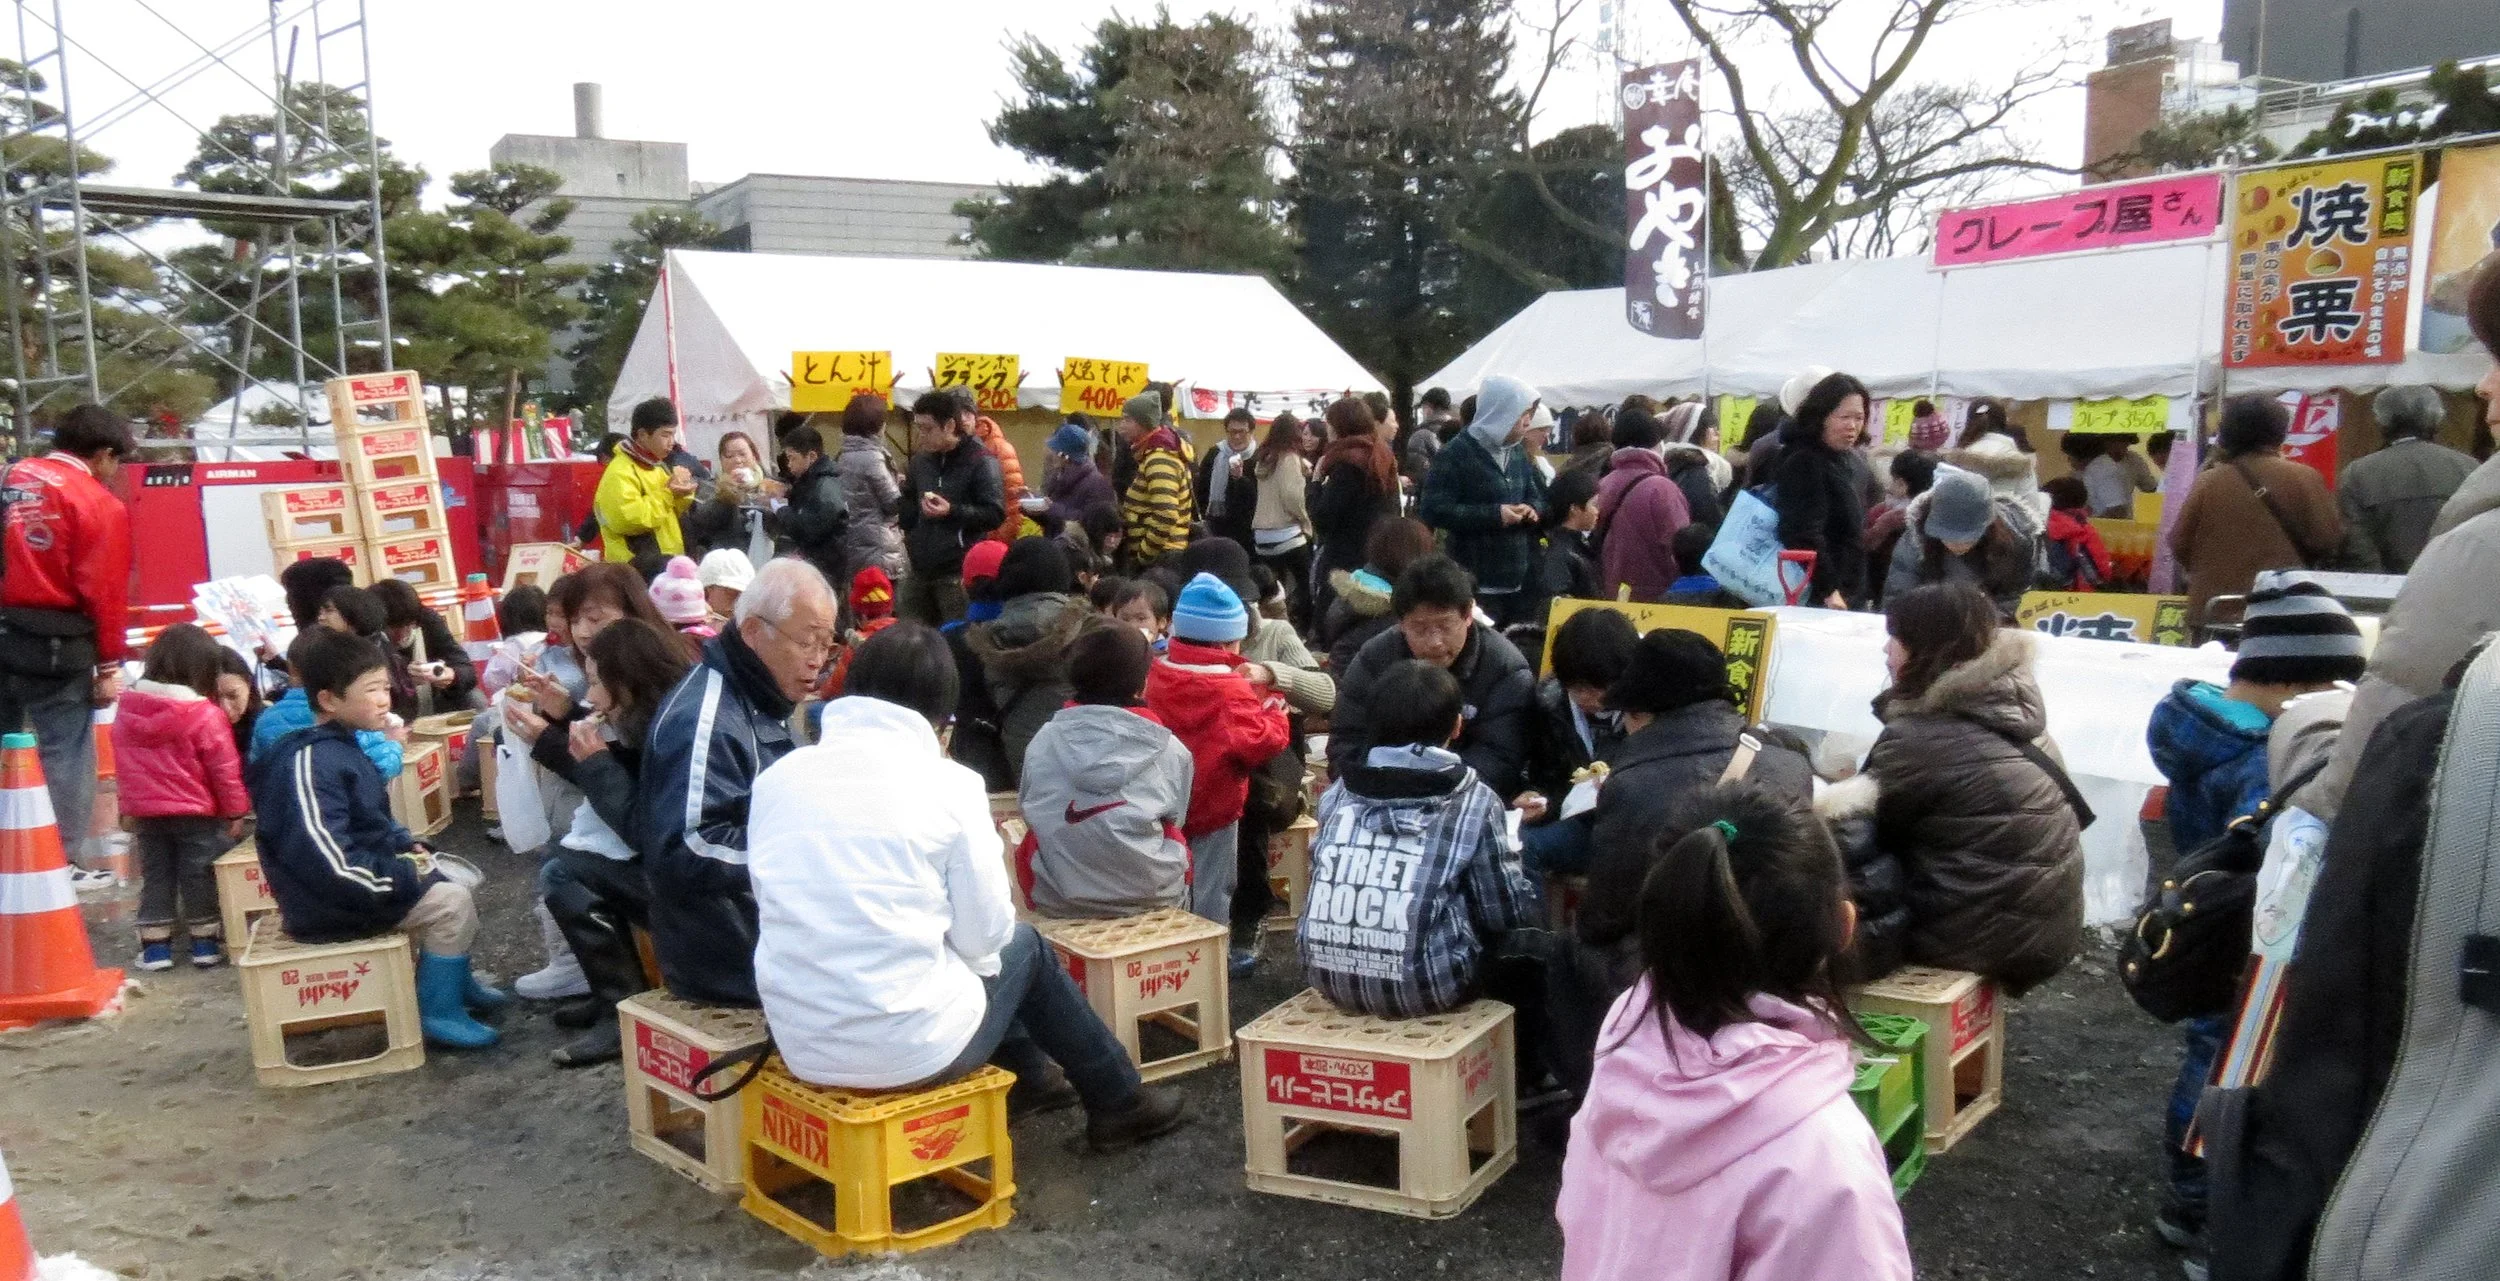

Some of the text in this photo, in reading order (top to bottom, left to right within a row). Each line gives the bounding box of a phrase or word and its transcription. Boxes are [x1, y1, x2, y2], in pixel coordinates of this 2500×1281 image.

[1625, 123, 1705, 308] おやき
[1953, 191, 2203, 254] クレープ屋さん
[804, 352, 880, 389] とん汁
[944, 355, 1014, 373] ジャンボ
[206, 469, 257, 479] AIRMAN
[1320, 844, 1422, 891] STREET
[1309, 880, 1414, 931] ROCK
[1352, 926, 1407, 952] STUDIO
[353, 961, 371, 976] 大
[1127, 961, 1142, 978] 20
[1186, 949, 1200, 965] 大
[299, 980, 360, 1008] Asahi
[1140, 970, 1189, 1000] Asahi
[1270, 1074, 1408, 1115] アサヒビール
[762, 1105, 829, 1169] KIRIN
